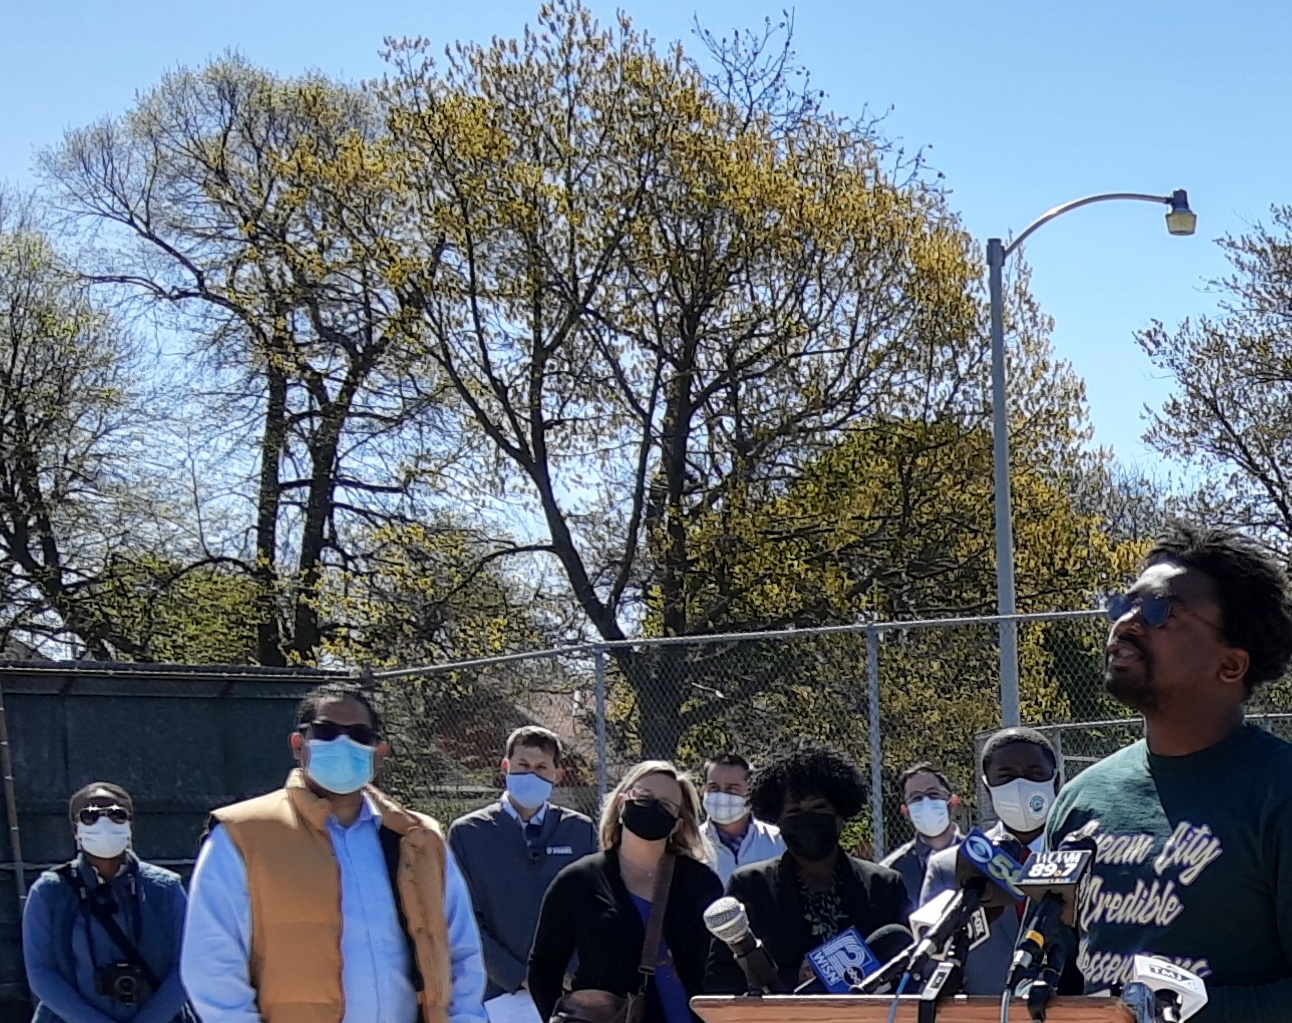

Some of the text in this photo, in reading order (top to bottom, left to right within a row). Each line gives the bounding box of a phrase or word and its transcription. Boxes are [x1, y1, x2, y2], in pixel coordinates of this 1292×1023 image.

[1084, 819, 1224, 887] ream City
[1028, 863, 1079, 877] 89.7
[1080, 875, 1186, 933] Credible
[971, 909, 985, 937] FOX
[813, 951, 842, 984] WISN
[846, 965, 862, 985] abc
